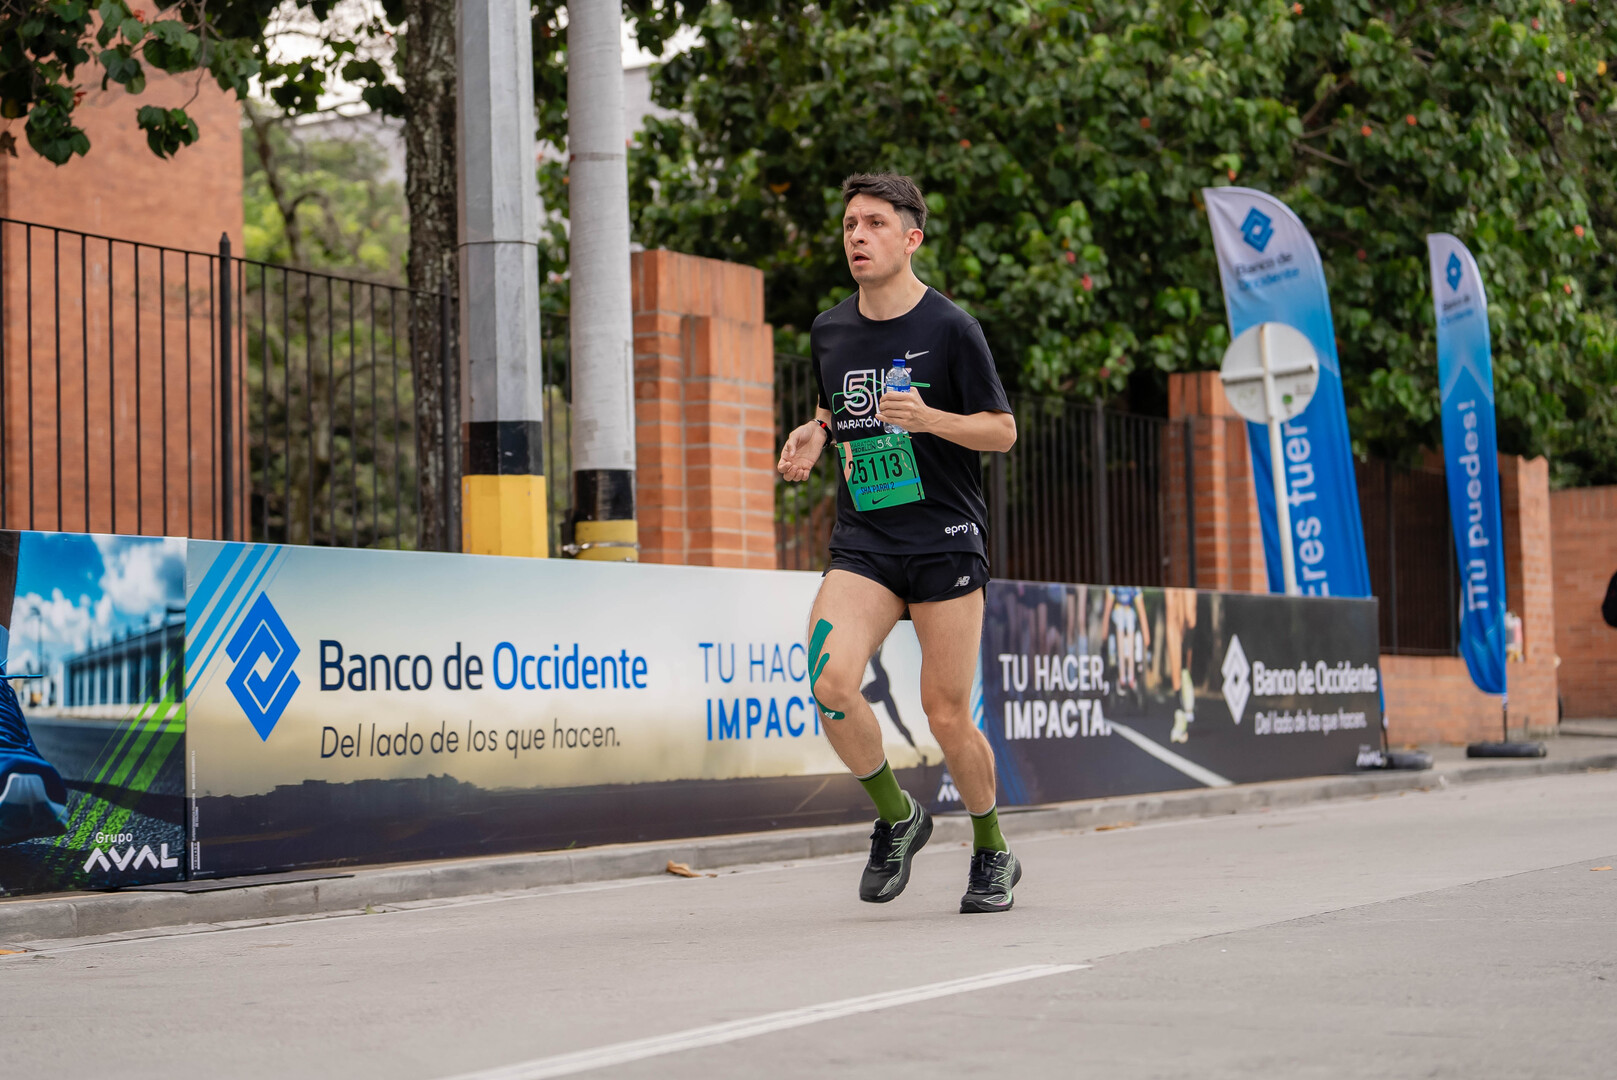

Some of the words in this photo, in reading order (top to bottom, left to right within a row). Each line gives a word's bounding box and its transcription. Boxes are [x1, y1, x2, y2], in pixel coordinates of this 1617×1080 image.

[837, 416, 881, 431] MARATÓN
[848, 453, 903, 485] 25113
[1457, 399, 1489, 548] puedes!
[319, 639, 433, 691] Banco
[443, 641, 483, 690] de
[492, 641, 648, 690] Occidente
[698, 643, 735, 683] TU
[998, 653, 1028, 692] TU
[1034, 653, 1110, 696] HACER,
[1252, 661, 1296, 696] Banco
[1297, 661, 1315, 695] de
[1315, 660, 1377, 695] Occidente
[320, 723, 362, 758] Del
[370, 722, 424, 757] lado
[430, 720, 460, 754] de
[467, 719, 498, 752] los
[505, 729, 546, 759] que
[552, 718, 621, 749] hacen.
[1004, 699, 1112, 740] IMPACTA.
[1255, 710, 1273, 735] Del
[95, 832, 133, 845] Grupo
[82, 843, 178, 873] AVAL
